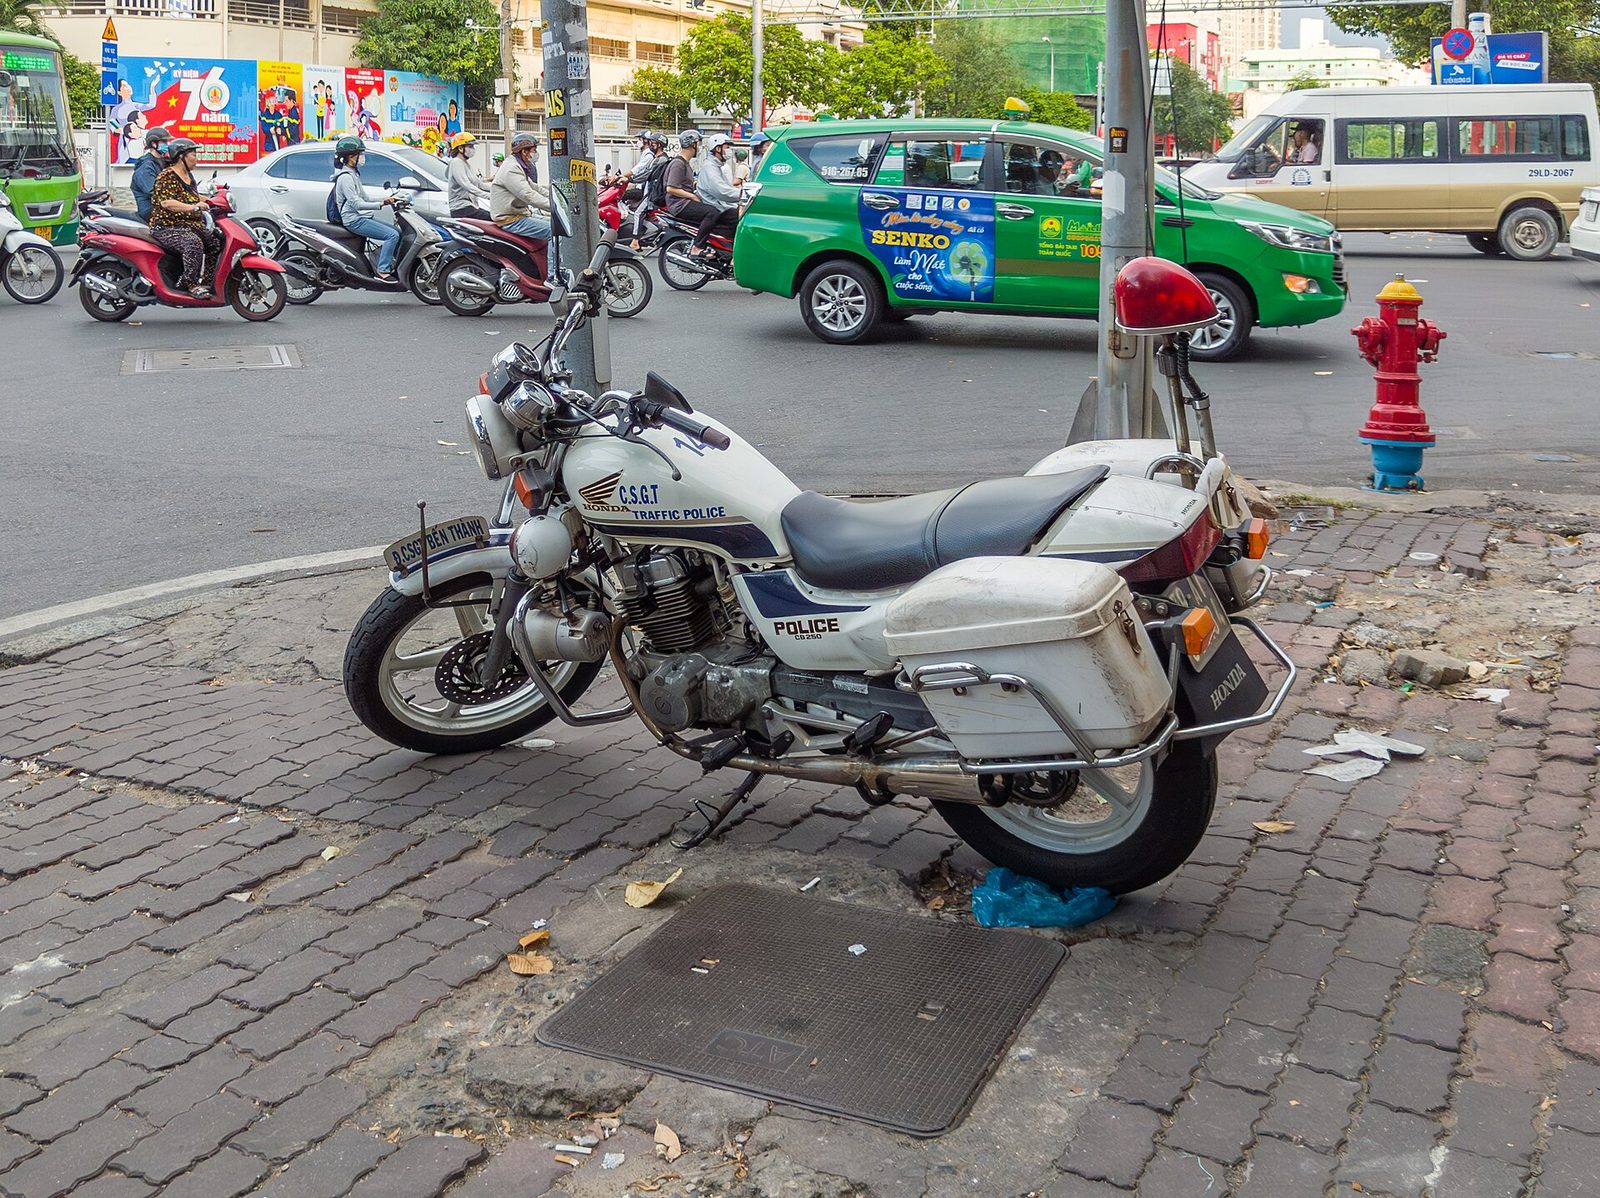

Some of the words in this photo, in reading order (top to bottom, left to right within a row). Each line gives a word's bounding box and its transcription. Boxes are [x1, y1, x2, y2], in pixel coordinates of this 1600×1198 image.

[179, 66, 230, 121] 76
[201, 111, 230, 122] năm
[1528, 168, 1575, 177] 29LD-2067
[872, 230, 950, 250] SENKO
[894, 256, 912, 266] Làm
[908, 272, 922, 281] cho
[895, 279, 914, 291] cuộc
[914, 281, 933, 293] sống
[619, 484, 658, 505] C.S.G.T
[581, 503, 632, 512] HONDA
[632, 509, 680, 520] TRAFFIC
[683, 506, 726, 520] POLICE
[425, 525, 450, 550] BẾN
[447, 518, 485, 542] THÀNH
[773, 617, 840, 636] POLICE
[1209, 662, 1247, 712] HONDA
